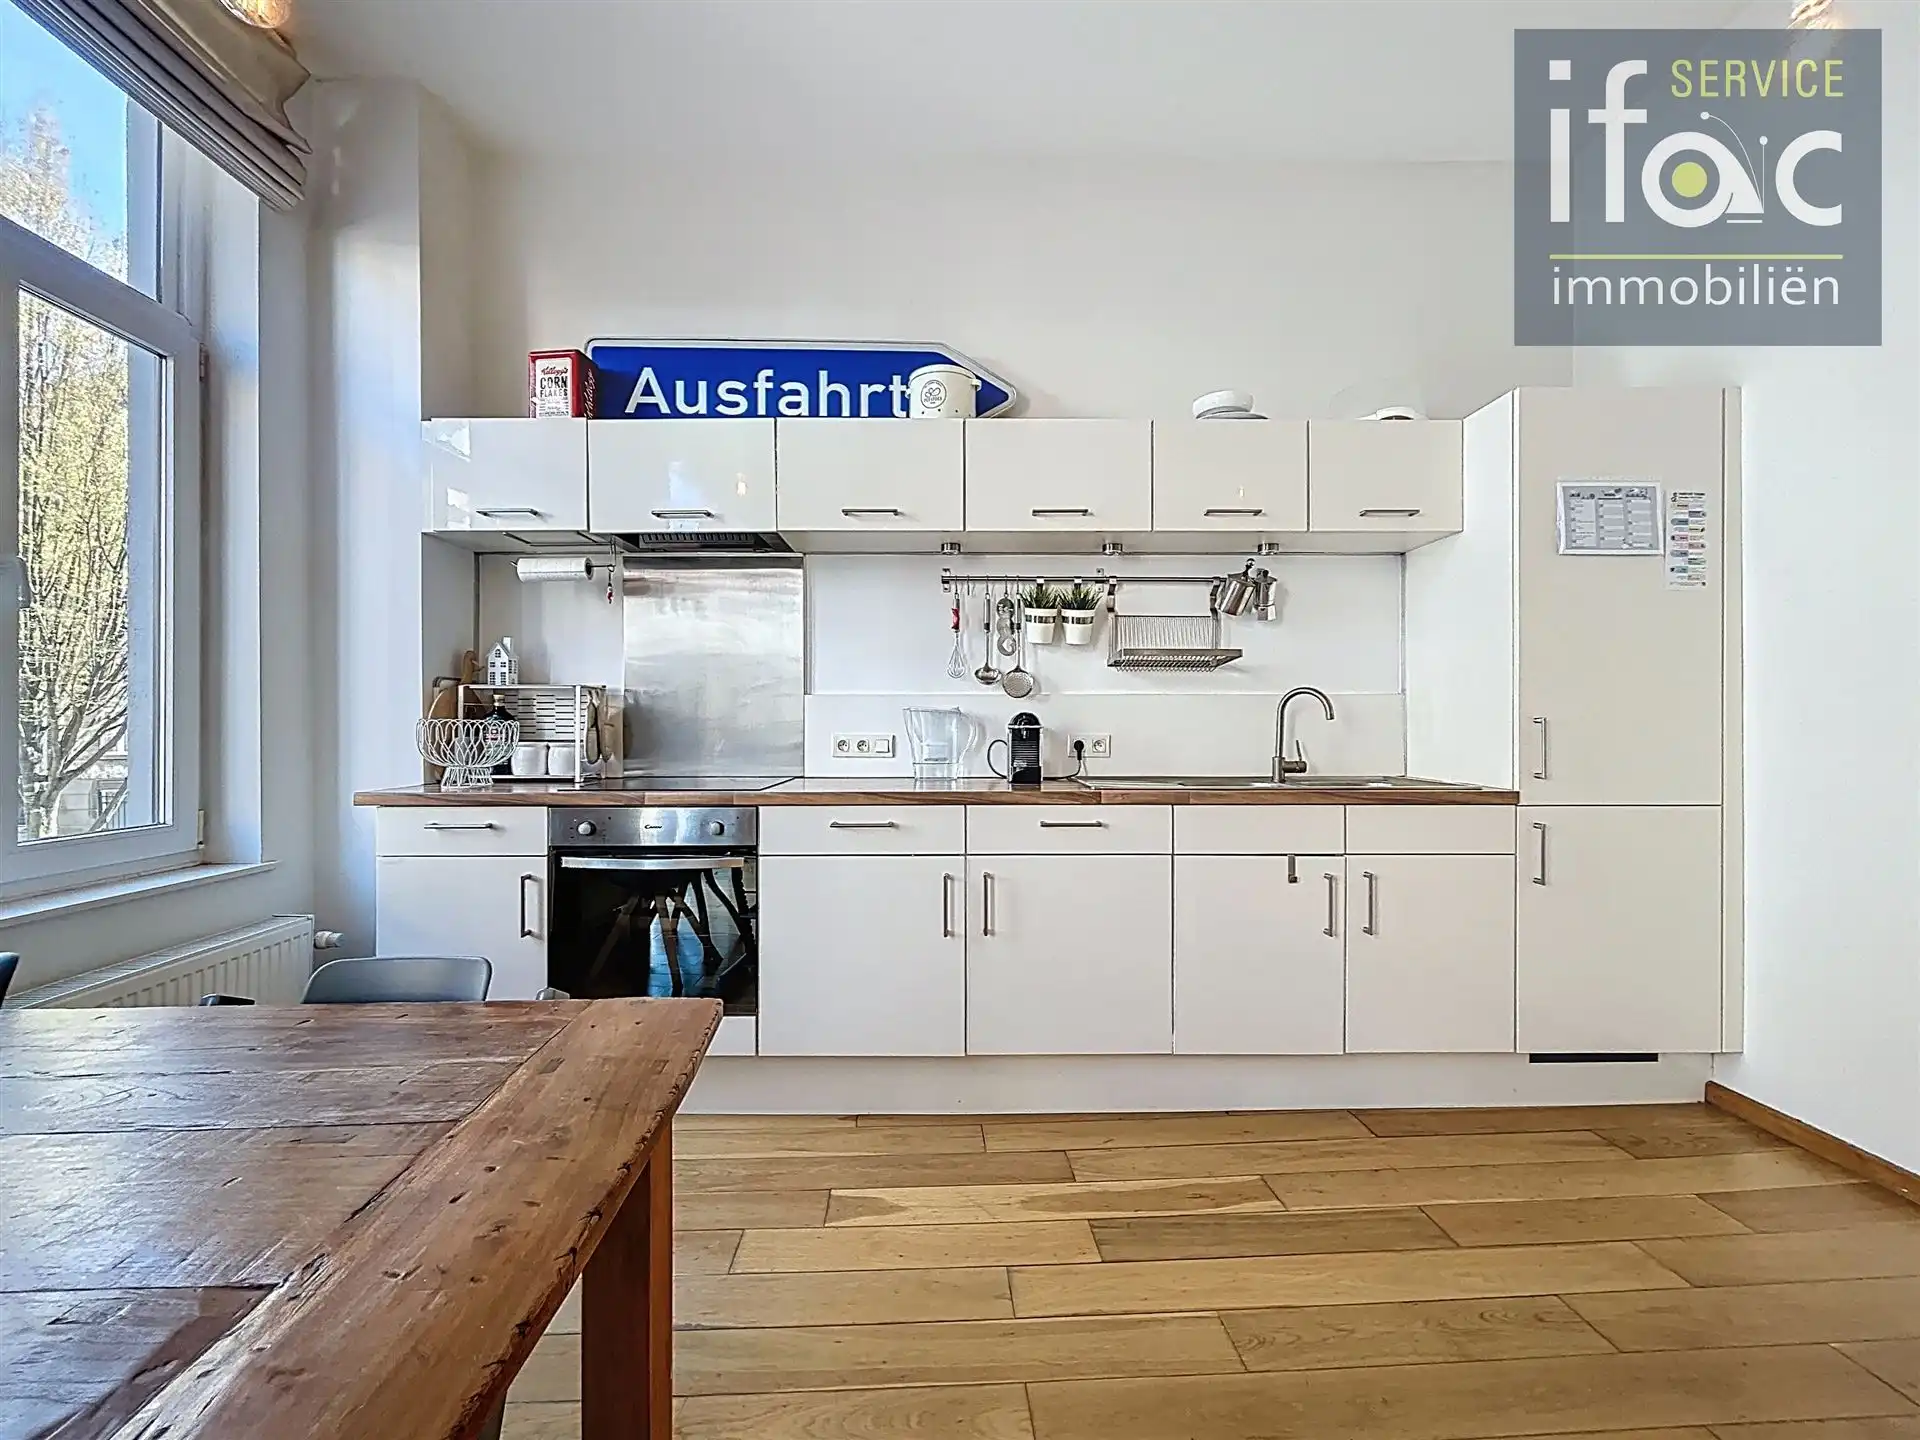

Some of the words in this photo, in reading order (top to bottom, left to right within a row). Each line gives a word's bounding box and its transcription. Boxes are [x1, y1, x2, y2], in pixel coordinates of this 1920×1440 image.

[540, 376, 568, 389] CORN
[540, 388, 568, 398] FLAKES
[625, 367, 910, 418] Ausfahrt
